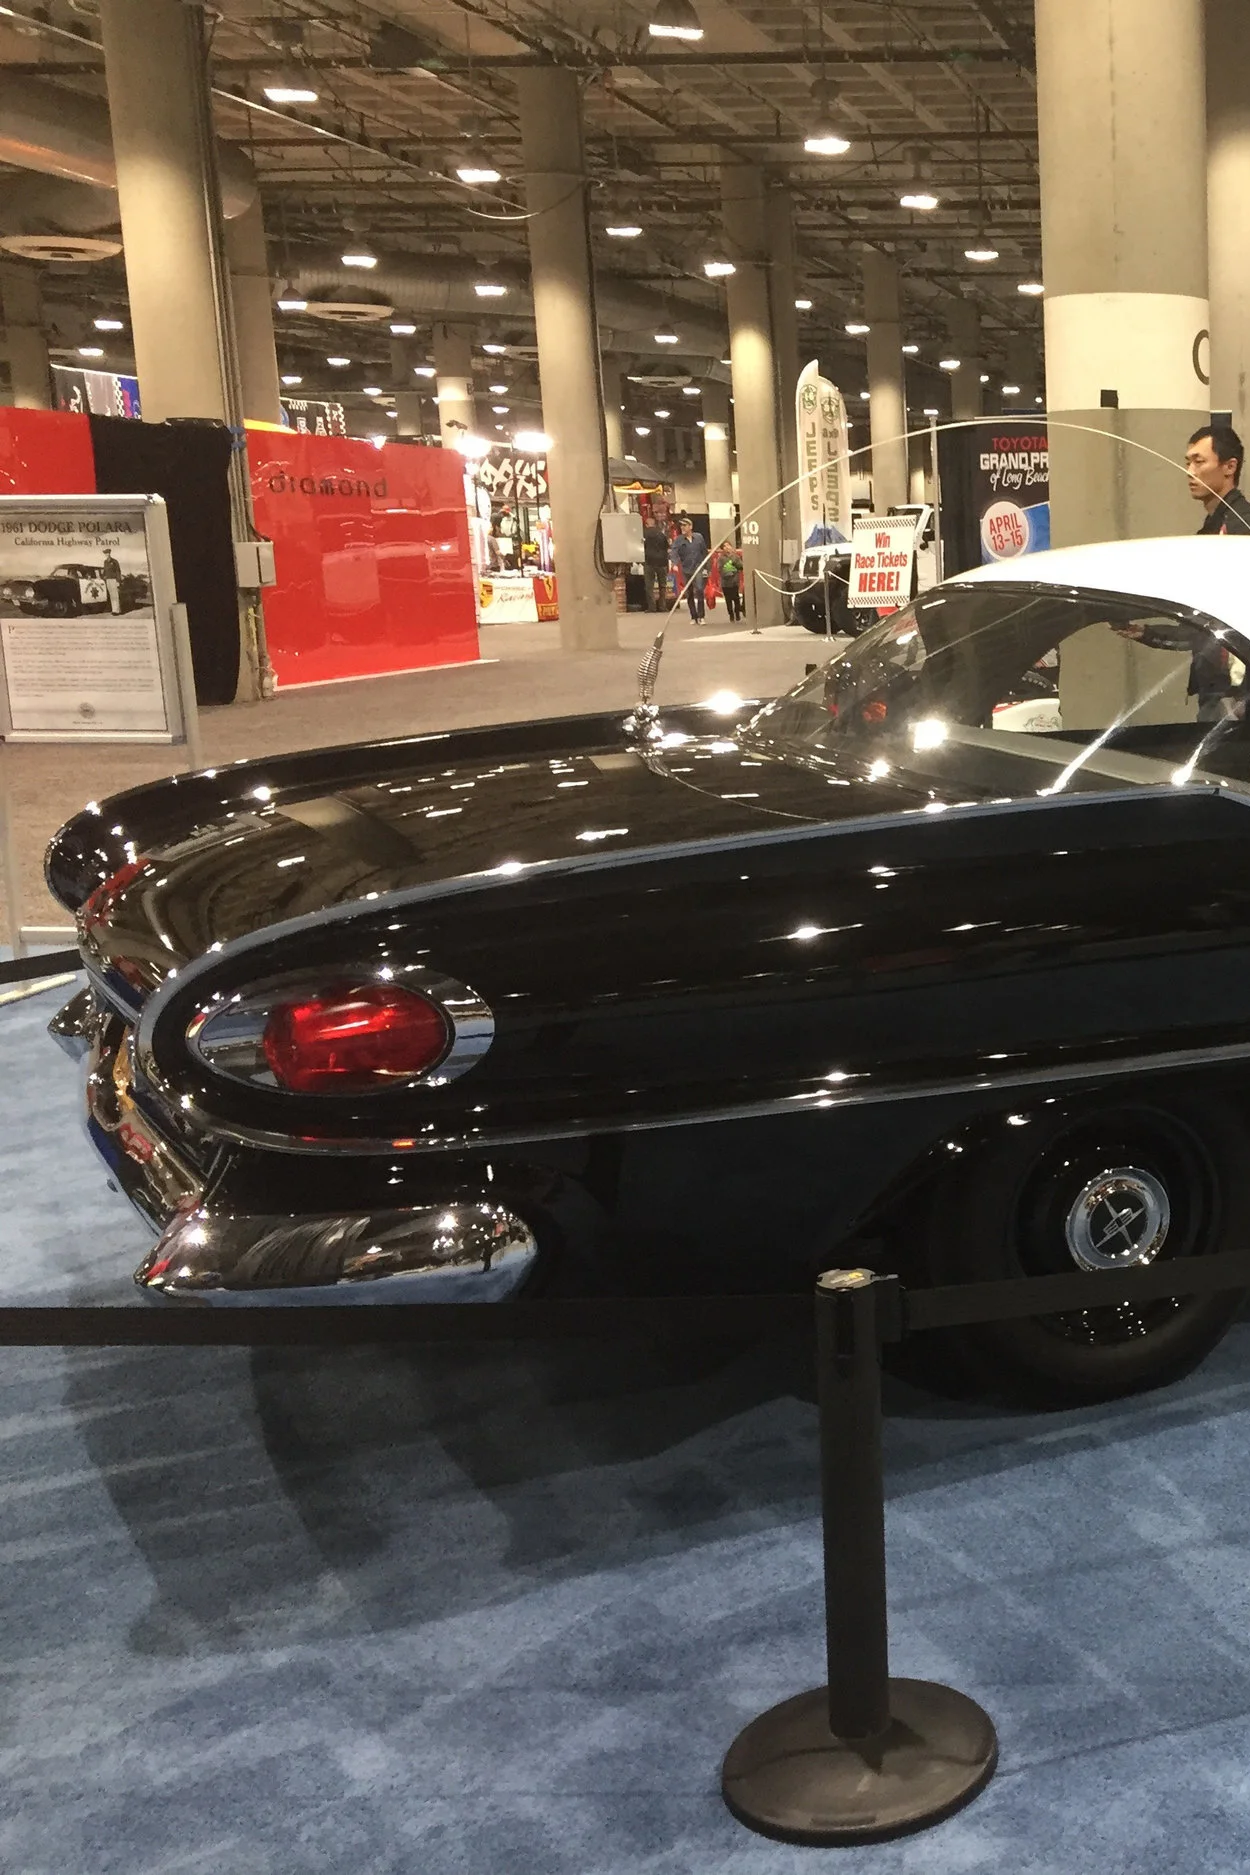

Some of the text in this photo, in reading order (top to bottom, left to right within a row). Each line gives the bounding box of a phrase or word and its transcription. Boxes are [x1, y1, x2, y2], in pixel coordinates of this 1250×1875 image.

[992, 435, 1048, 451] TOYOTA
[806, 421, 819, 511] JEEPS
[980, 452, 1028, 470] GRAND
[269, 471, 388, 498] diamond
[990, 466, 1049, 491] of Long Beac
[2, 521, 132, 534] 1961 DODGE POLARA
[742, 521, 759, 535] 10
[989, 513, 1022, 535] APRIL
[14, 537, 120, 548] California Highway Patrol
[875, 532, 890, 549] Win
[992, 529, 1024, 551] 13-15
[855, 551, 908, 569] Race Tickets
[858, 571, 900, 593] HERE!
